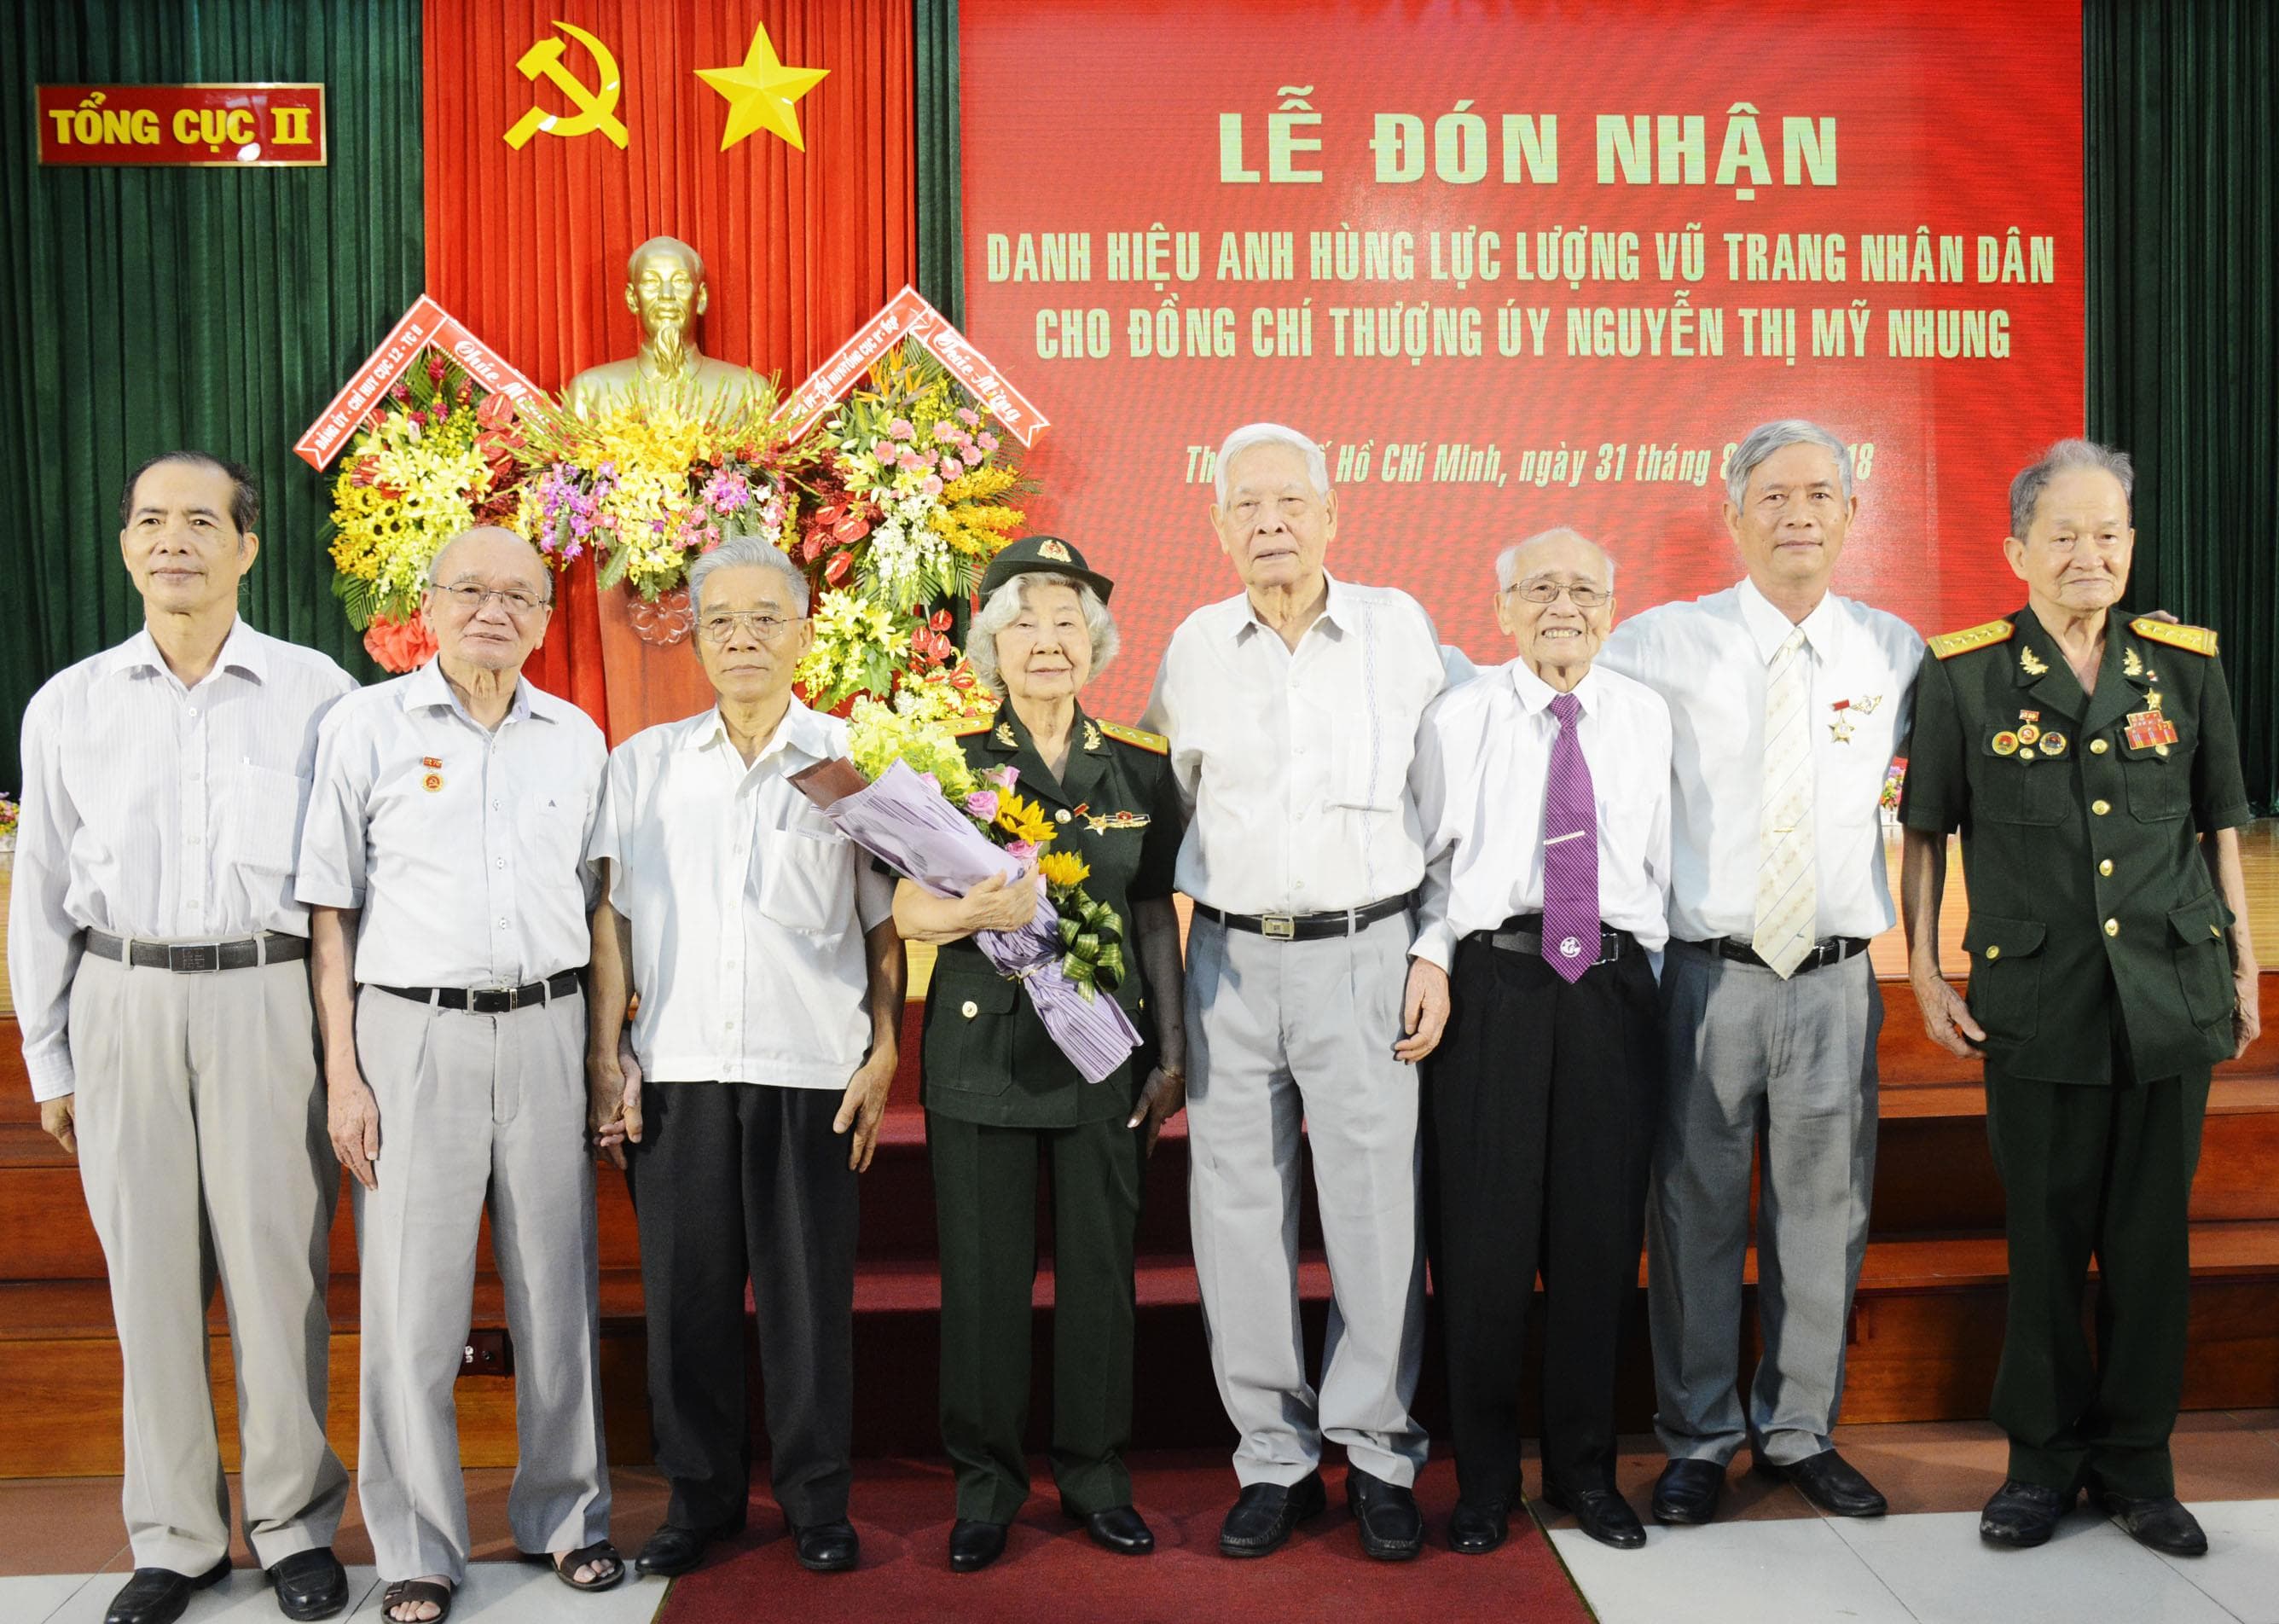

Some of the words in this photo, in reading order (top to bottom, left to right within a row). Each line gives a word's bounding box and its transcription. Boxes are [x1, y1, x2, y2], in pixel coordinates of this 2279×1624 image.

[49, 91, 160, 144] TỔNG
[172, 108, 256, 154] CỤC
[270, 107, 313, 144] II
[1219, 86, 1324, 183] LỄ
[1369, 99, 1558, 184] ĐÓN
[1596, 102, 1838, 201] NHẬN
[987, 232, 1091, 282] DANH
[1107, 223, 1200, 291] HIỆU
[1216, 231, 1294, 281] ANH
[1310, 223, 1414, 281] HÙNG
[1430, 224, 1501, 291] LỰC
[1516, 224, 1639, 290] LƯỢNG
[1655, 222, 1705, 282] VŨ
[1723, 233, 1846, 282] TRANG
[1860, 225, 1963, 283] NHÂN
[1977, 226, 2055, 283] DÂN
[1035, 308, 1111, 359] CHO
[1127, 292, 1236, 359] ĐỒNG
[1251, 297, 1313, 358] CHÍ
[1328, 299, 1482, 367] THƯỢNG
[1497, 298, 1551, 358] ÚY
[1566, 290, 1724, 357] NGUYỄN
[1737, 308, 1796, 366] THỊ
[1812, 299, 1871, 357] MỸ
[1888, 309, 2010, 358] NHUNG
[314, 423, 341, 450] ĐẢNG
[332, 410, 351, 428] ỦY
[347, 389, 367, 411] CHỈ
[358, 376, 380, 397] HUY
[373, 359, 394, 380] CỤC
[388, 347, 404, 363] 12
[400, 332, 418, 346] TC
[1335, 438, 1375, 483] Hồ
[1518, 441, 1587, 488] ngày
[1594, 442, 1628, 482] 31
[1635, 442, 1712, 487] tháng
